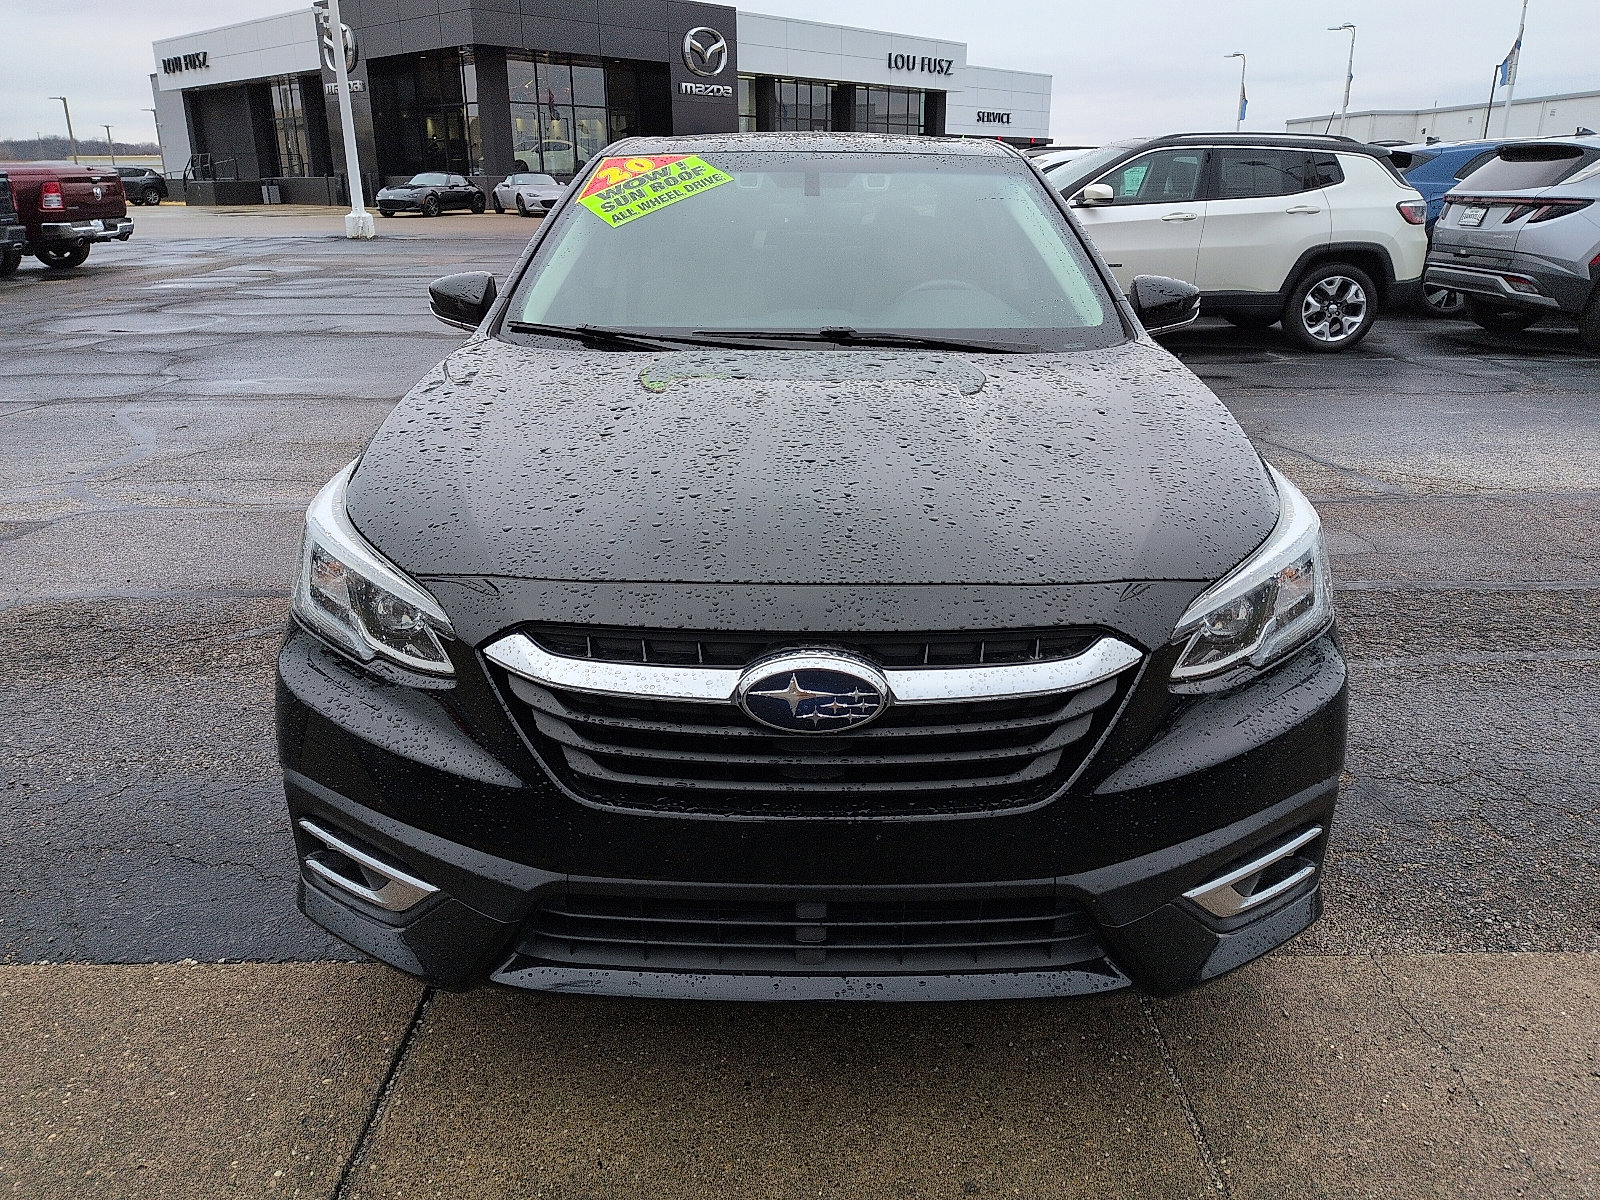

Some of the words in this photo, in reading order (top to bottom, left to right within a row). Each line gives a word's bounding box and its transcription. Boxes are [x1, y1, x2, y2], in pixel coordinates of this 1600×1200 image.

[888, 53, 916, 71] LOU
[920, 56, 954, 76] FUSZ
[976, 111, 1012, 124] SERVICE
[595, 166, 672, 200] WOW
[597, 157, 655, 185] 20
[601, 188, 647, 213] SUN
[651, 165, 707, 193] ROOF
[611, 207, 637, 224] ALL
[638, 189, 685, 212] WHEEL
[683, 173, 723, 192] DRIVE
